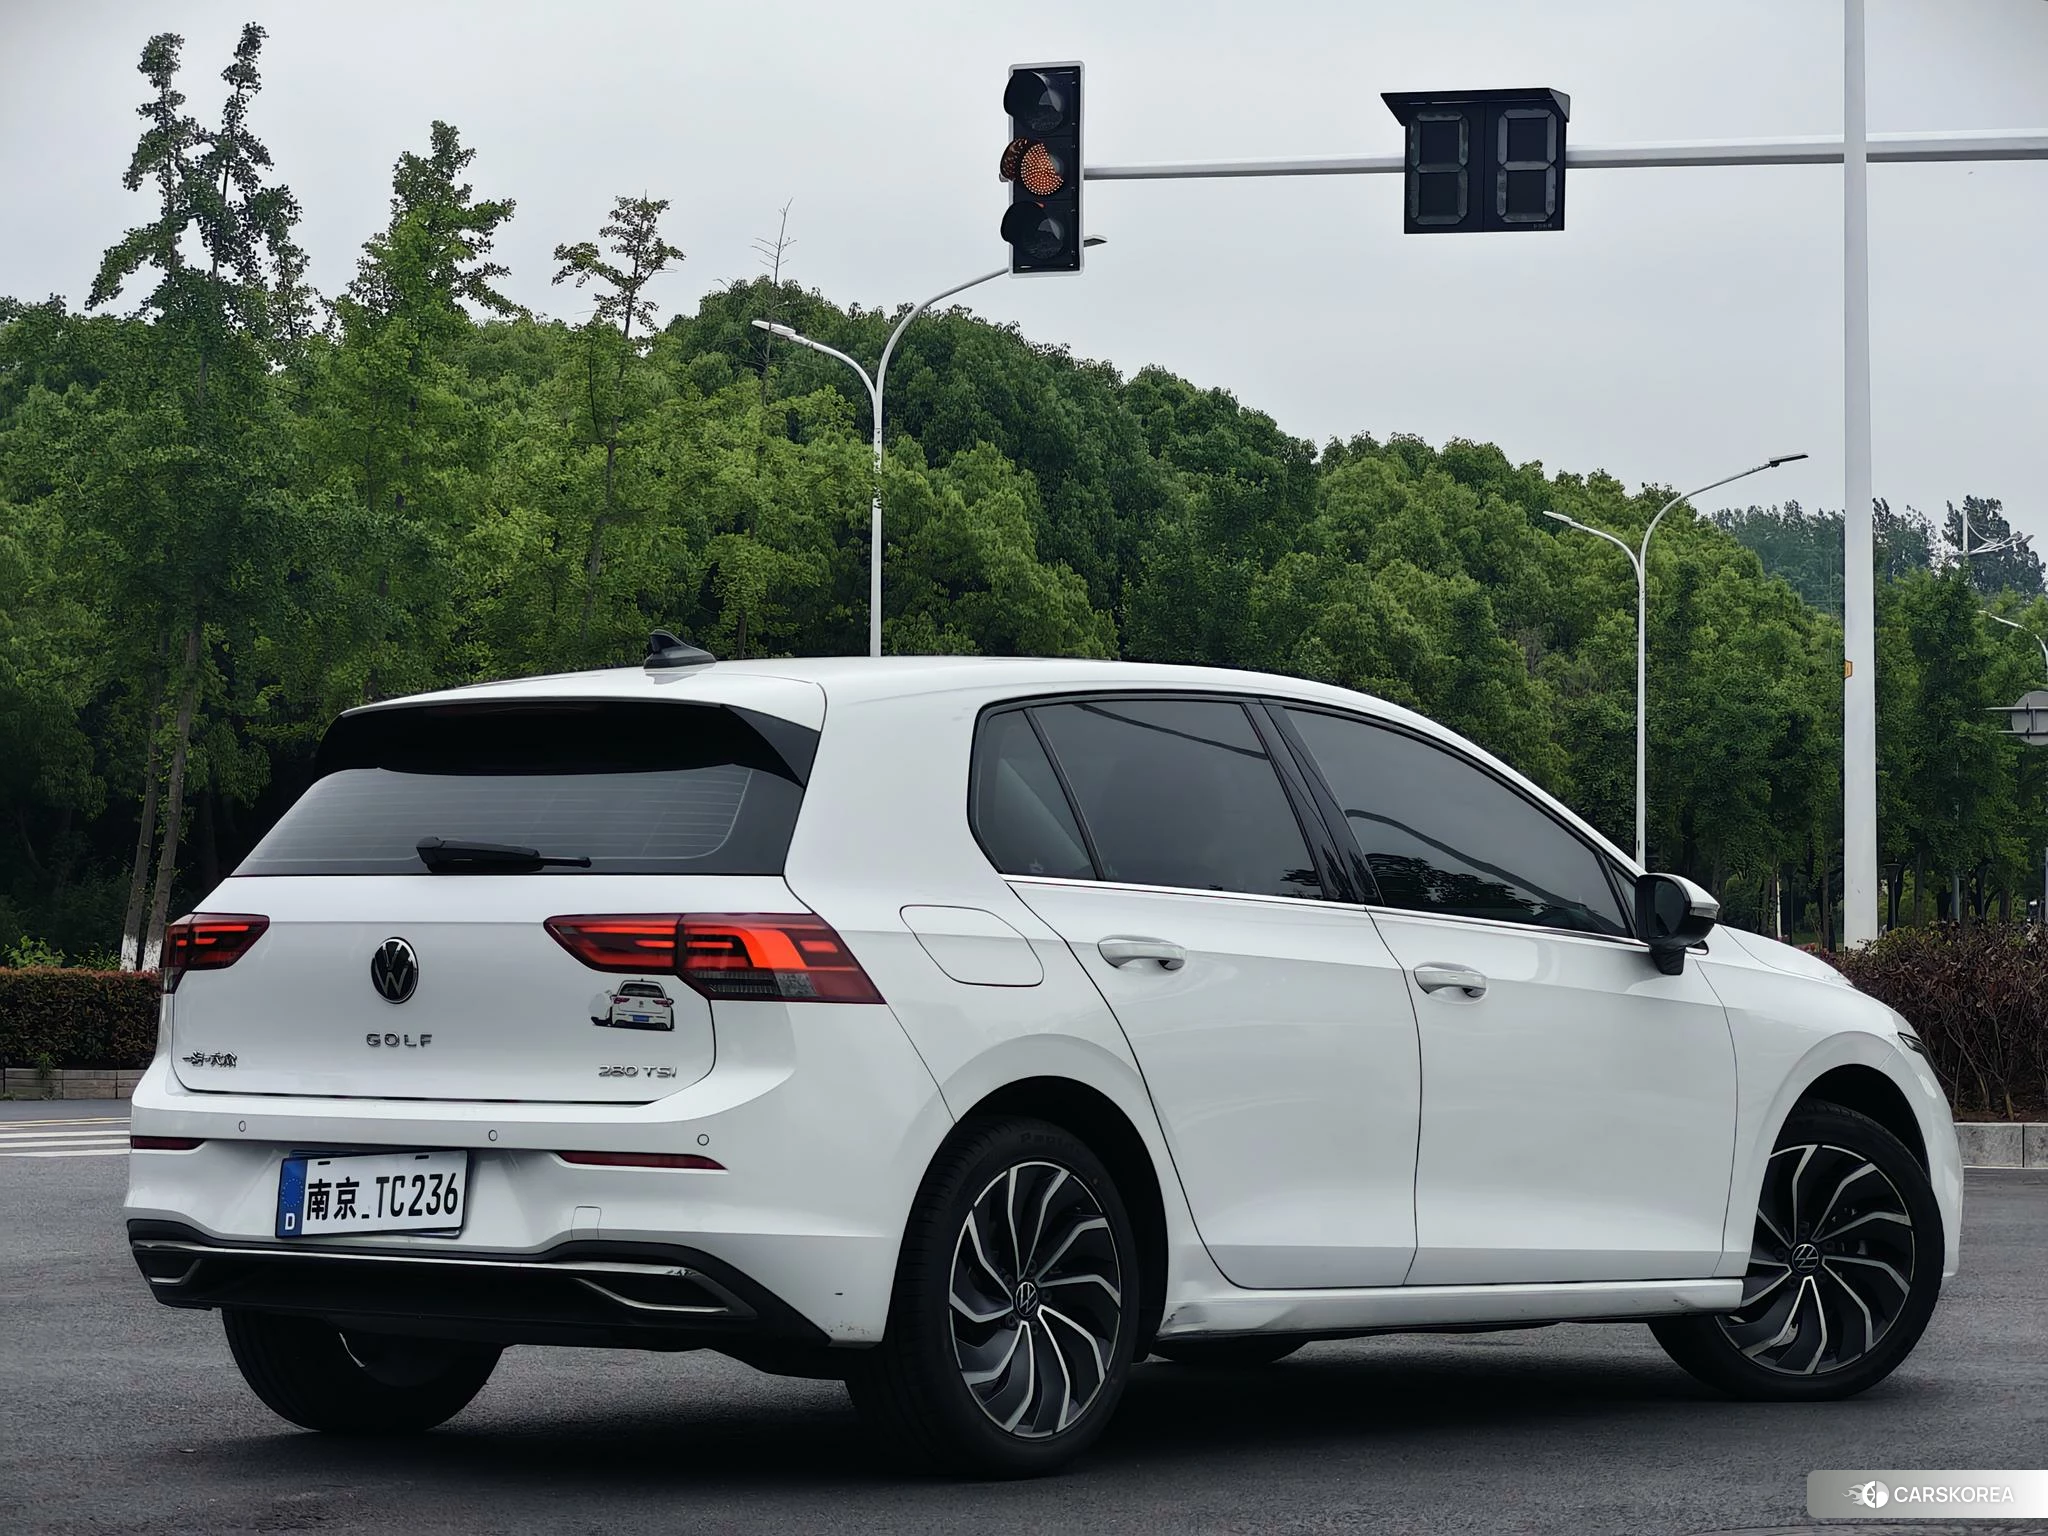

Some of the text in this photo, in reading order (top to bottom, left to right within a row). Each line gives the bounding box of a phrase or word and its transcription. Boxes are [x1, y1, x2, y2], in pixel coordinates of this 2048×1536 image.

[366, 1033, 432, 1047] GOLF
[598, 1065, 678, 1078] 280 TSI
[284, 1212, 296, 1231] D
